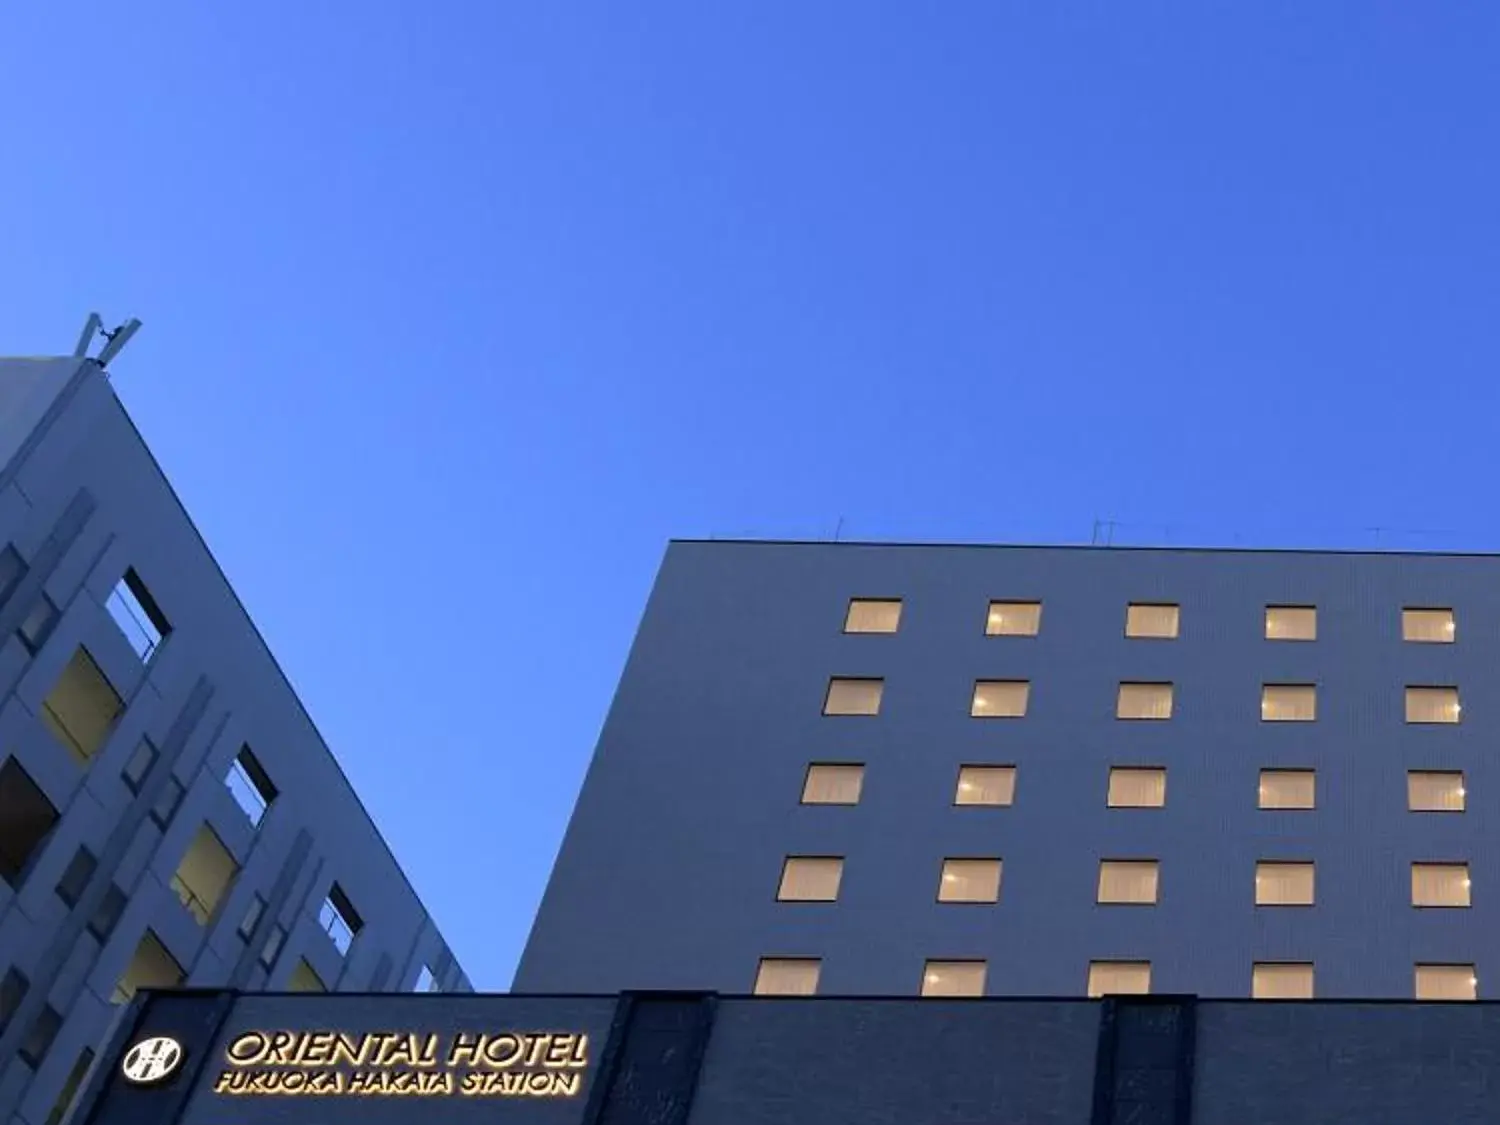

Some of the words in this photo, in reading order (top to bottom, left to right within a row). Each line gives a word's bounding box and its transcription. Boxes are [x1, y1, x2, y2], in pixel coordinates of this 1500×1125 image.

[226, 1031, 436, 1065] ORIENTAL
[447, 1033, 587, 1067] HOTEL
[213, 1070, 343, 1094] FUKUOKA
[347, 1071, 452, 1095] HAKATA
[460, 1071, 580, 1095] STATION
